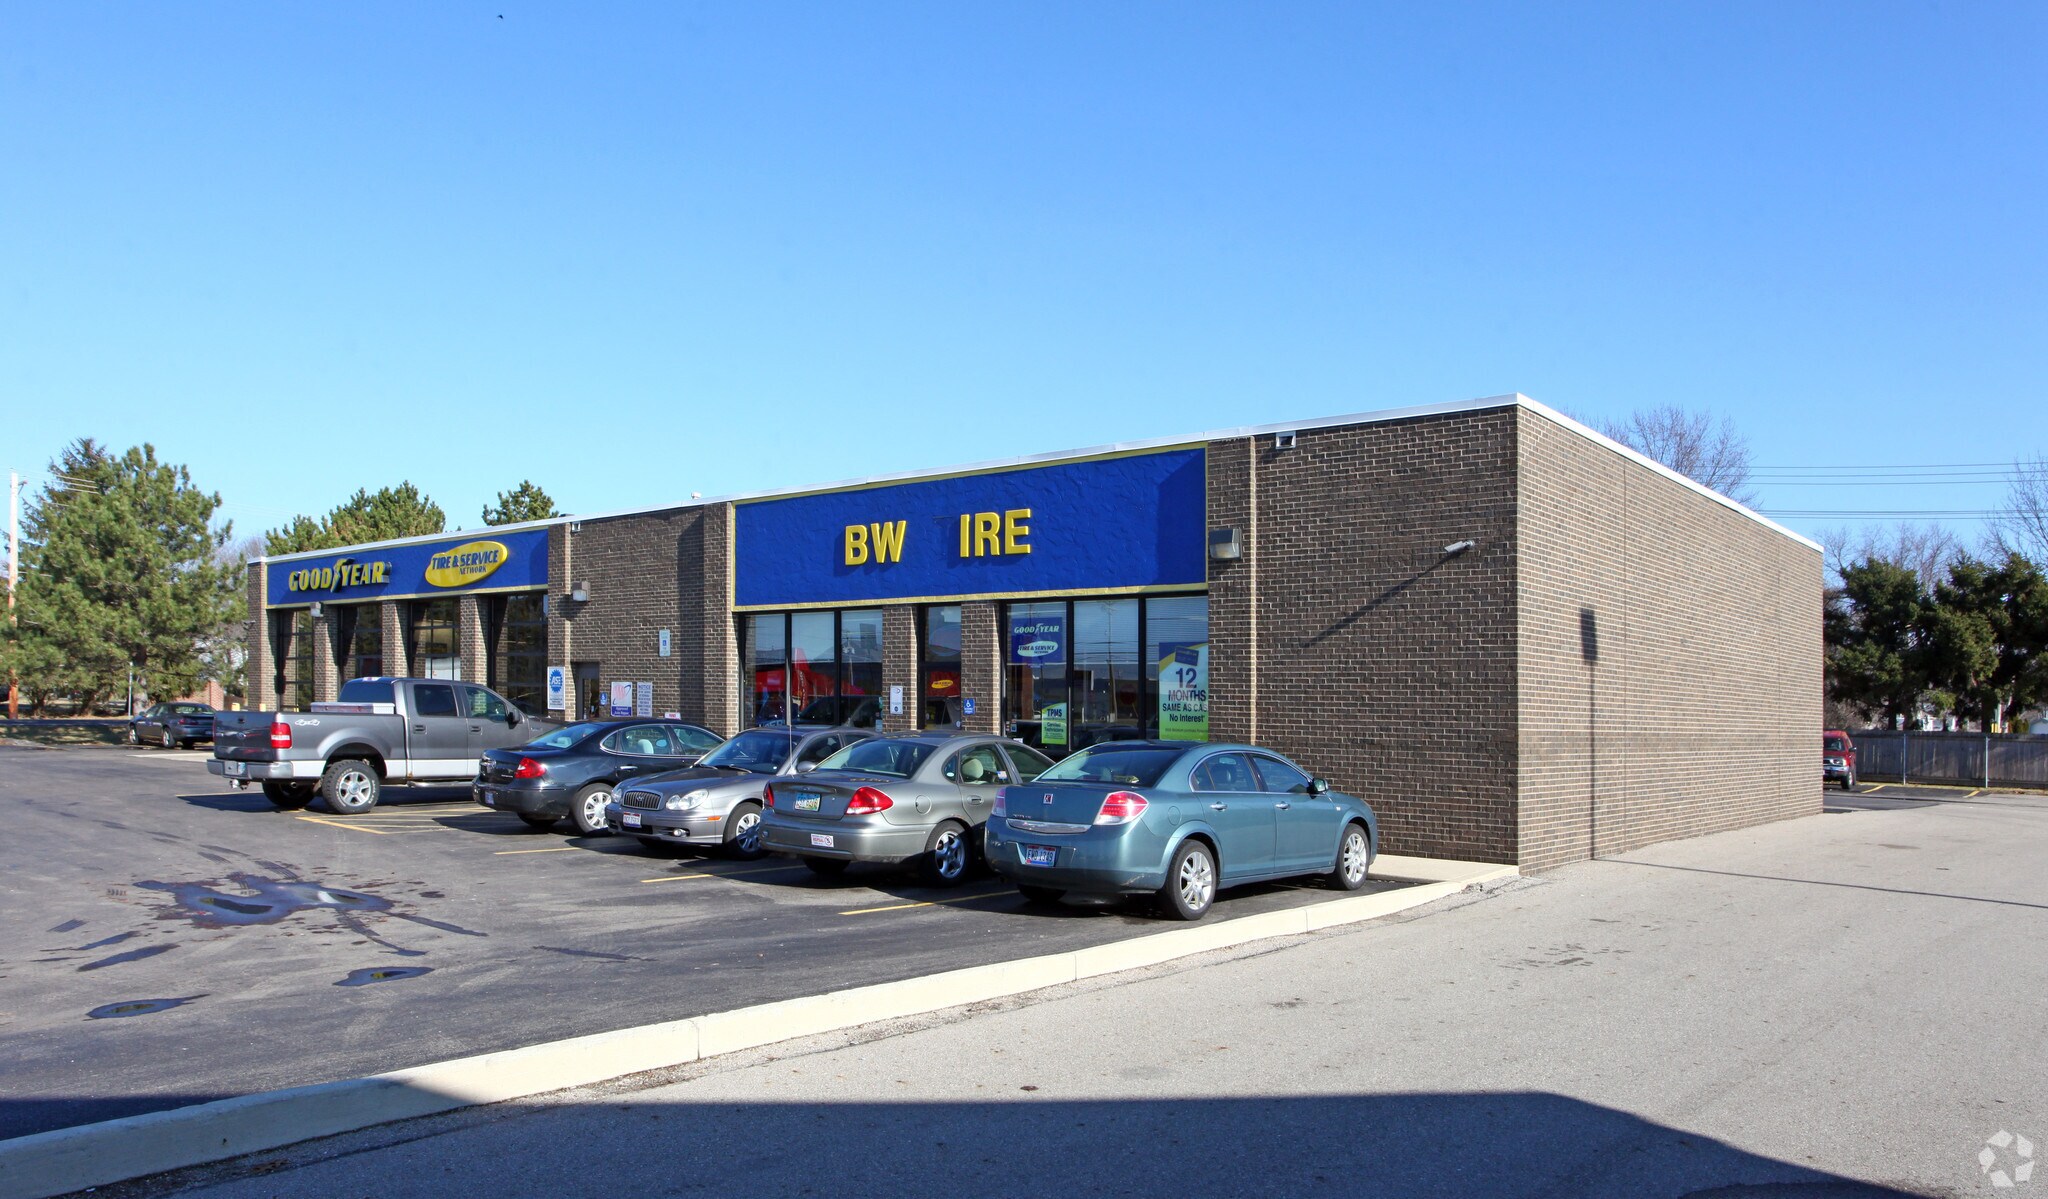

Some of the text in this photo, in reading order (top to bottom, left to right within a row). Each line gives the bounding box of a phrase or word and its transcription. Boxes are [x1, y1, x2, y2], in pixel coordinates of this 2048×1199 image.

[844, 507, 1032, 566] BW IRE
[432, 549, 500, 570] TIRE & SERVICE
[288, 558, 390, 593] GOODYEAR
[459, 565, 487, 576] NETWORK
[1014, 623, 1060, 635] GOODYEAR
[1175, 667, 1197, 689] 12
[1168, 689, 1207, 702] MONTHS
[1047, 708, 1063, 718] TPMS
[1162, 703, 1181, 712] SAME
[1182, 703, 1192, 712] AS
[1169, 713, 1179, 722] No
